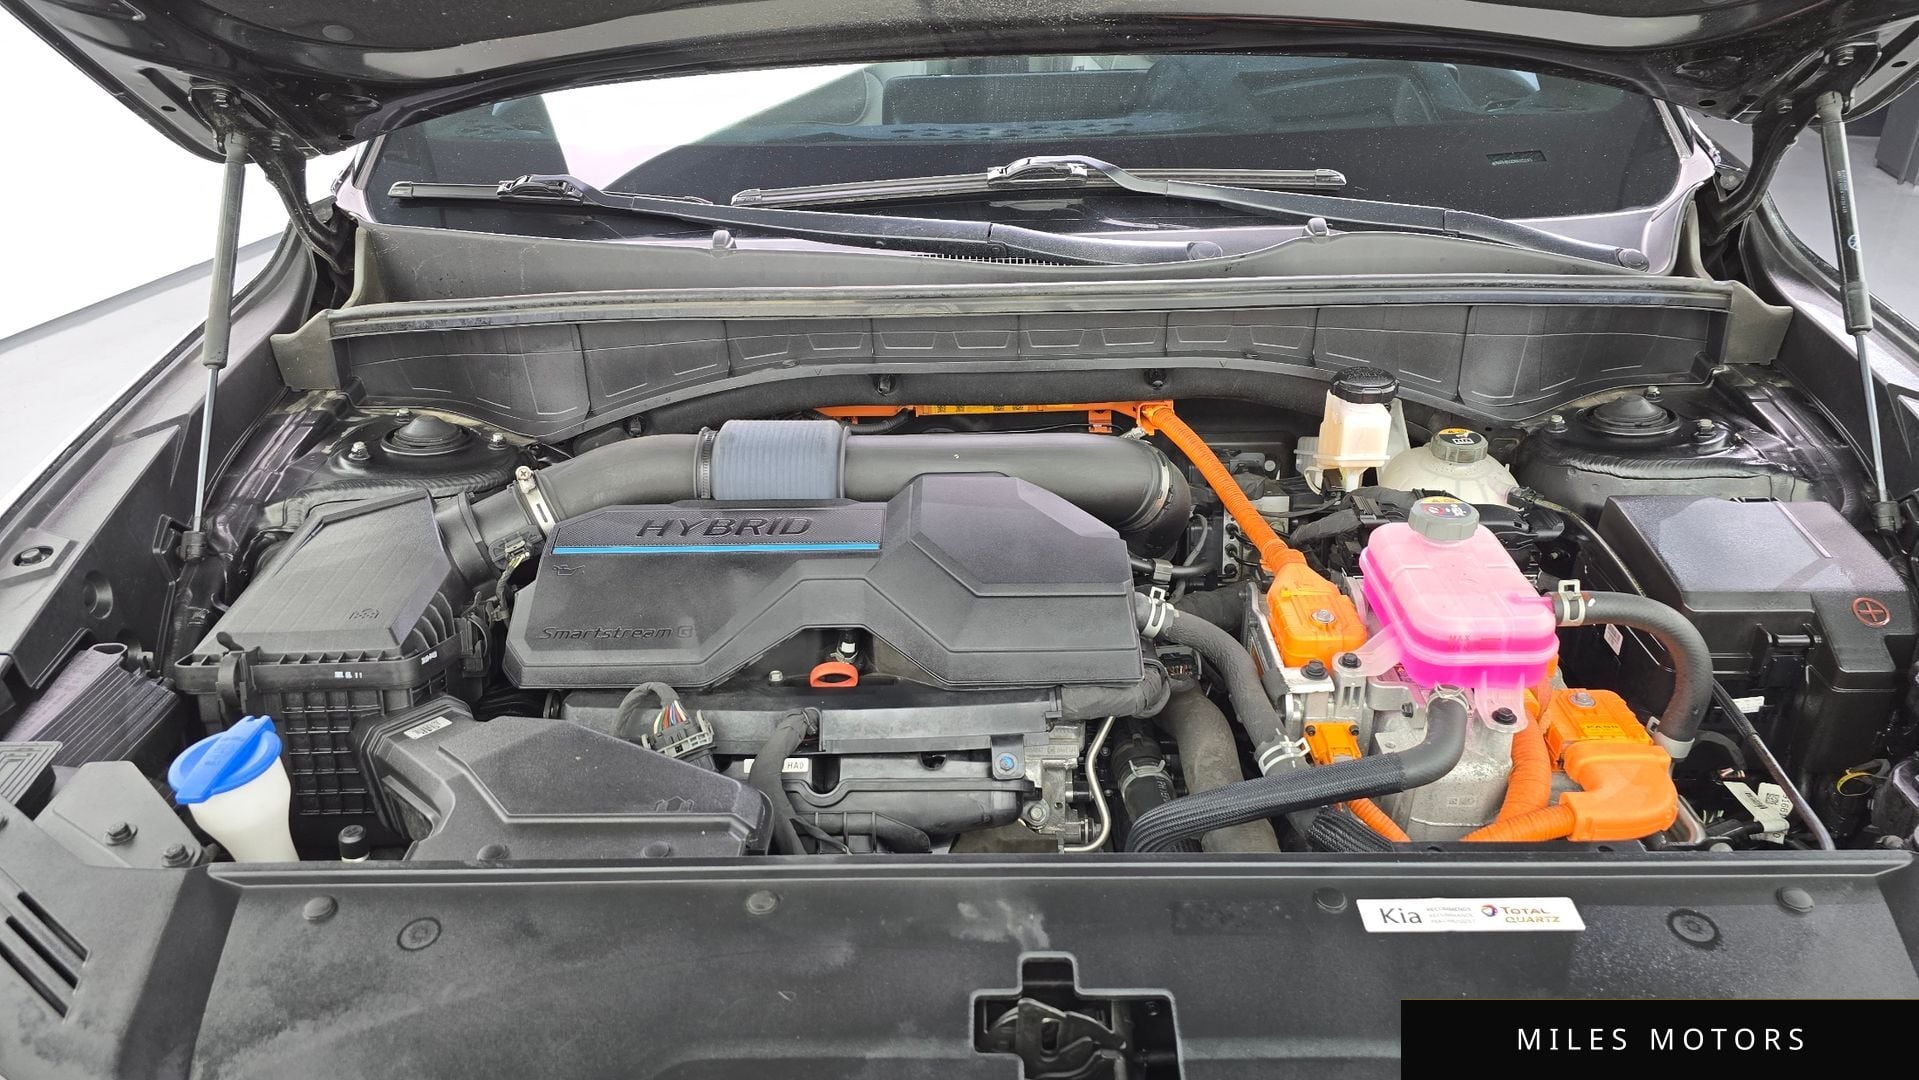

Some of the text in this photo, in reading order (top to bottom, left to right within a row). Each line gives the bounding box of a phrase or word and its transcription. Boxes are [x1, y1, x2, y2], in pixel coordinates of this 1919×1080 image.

[635, 517, 813, 538] HYBRID
[539, 625, 673, 641] Smartstream
[1379, 907, 1423, 924] Kia
[1501, 906, 1550, 915] TOTAL
[1505, 916, 1561, 924] QUARTZ
